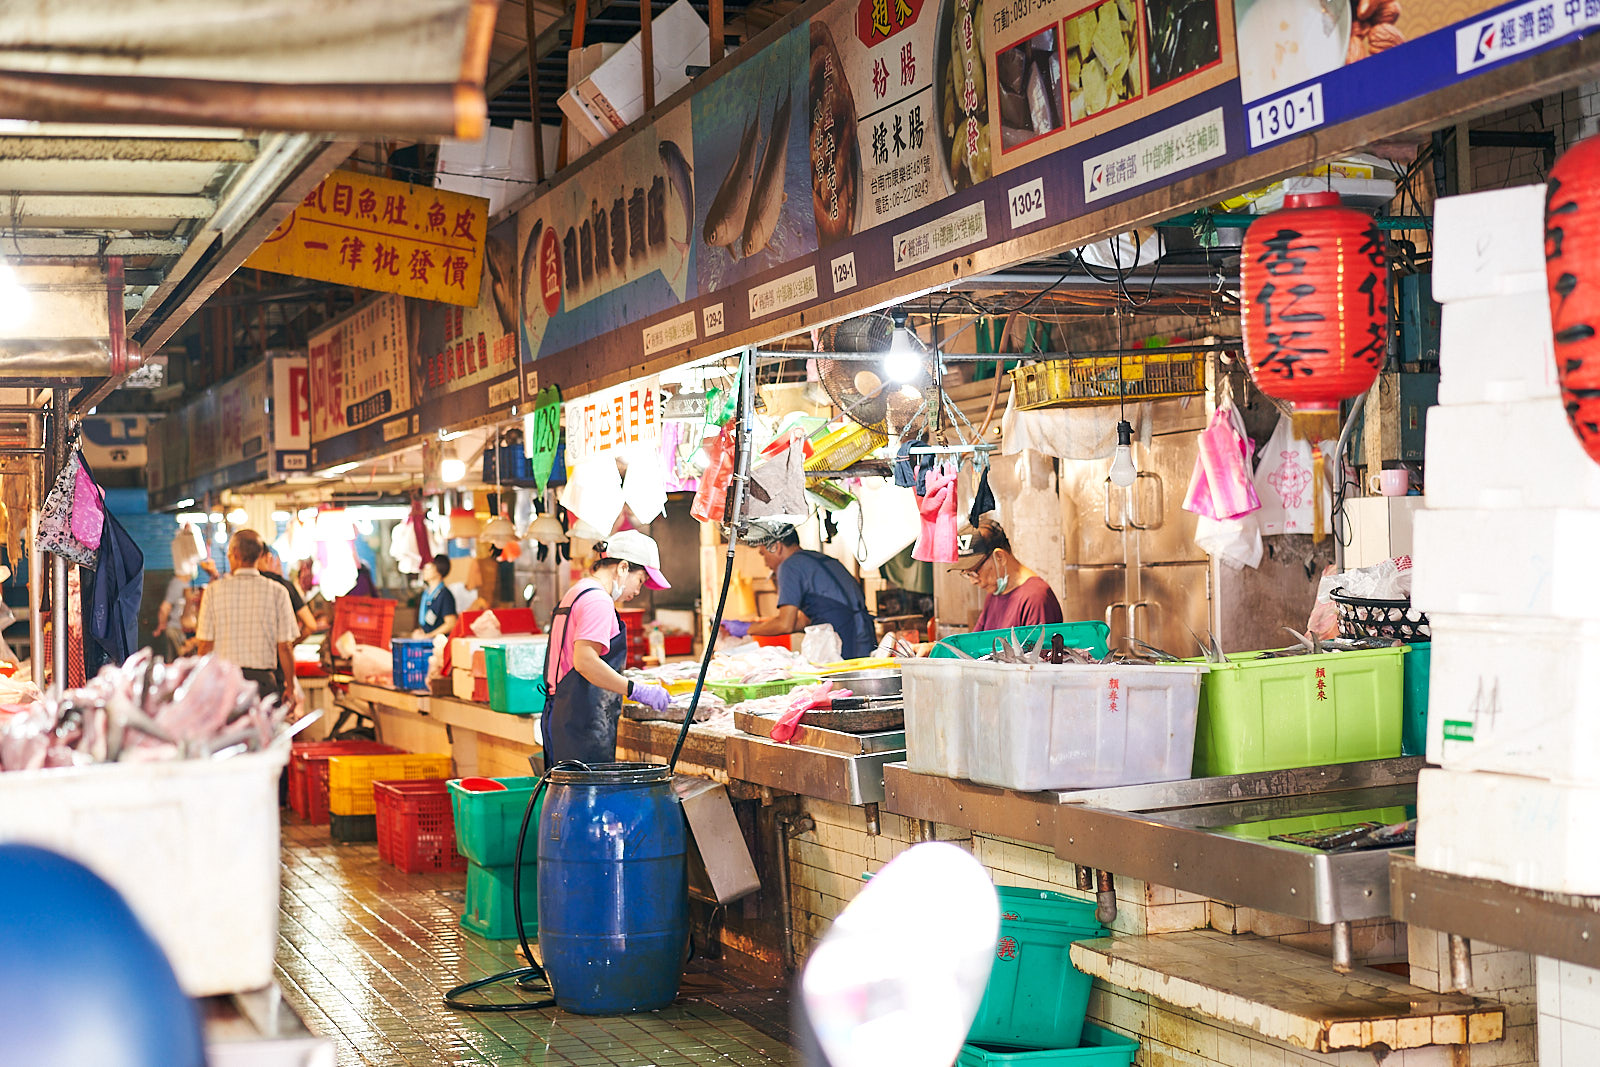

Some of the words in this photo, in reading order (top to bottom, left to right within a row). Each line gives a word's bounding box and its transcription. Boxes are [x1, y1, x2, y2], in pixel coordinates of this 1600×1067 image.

[1501, 4, 1554, 48] 經濟部
[872, 41, 916, 101] 粉腸
[872, 105, 925, 166] 糯米腸
[1256, 91, 1315, 140] 130-1
[1106, 154, 1137, 188] 經濟部
[1012, 188, 1043, 217] 130-2
[303, 235, 470, 291] 一律批發價
[833, 264, 855, 283] 129-1
[705, 310, 723, 329] 129-2
[1256, 229, 1329, 380] 杏仁茶
[535, 405, 556, 454] 128
[997, 938, 1016, 960] 義
